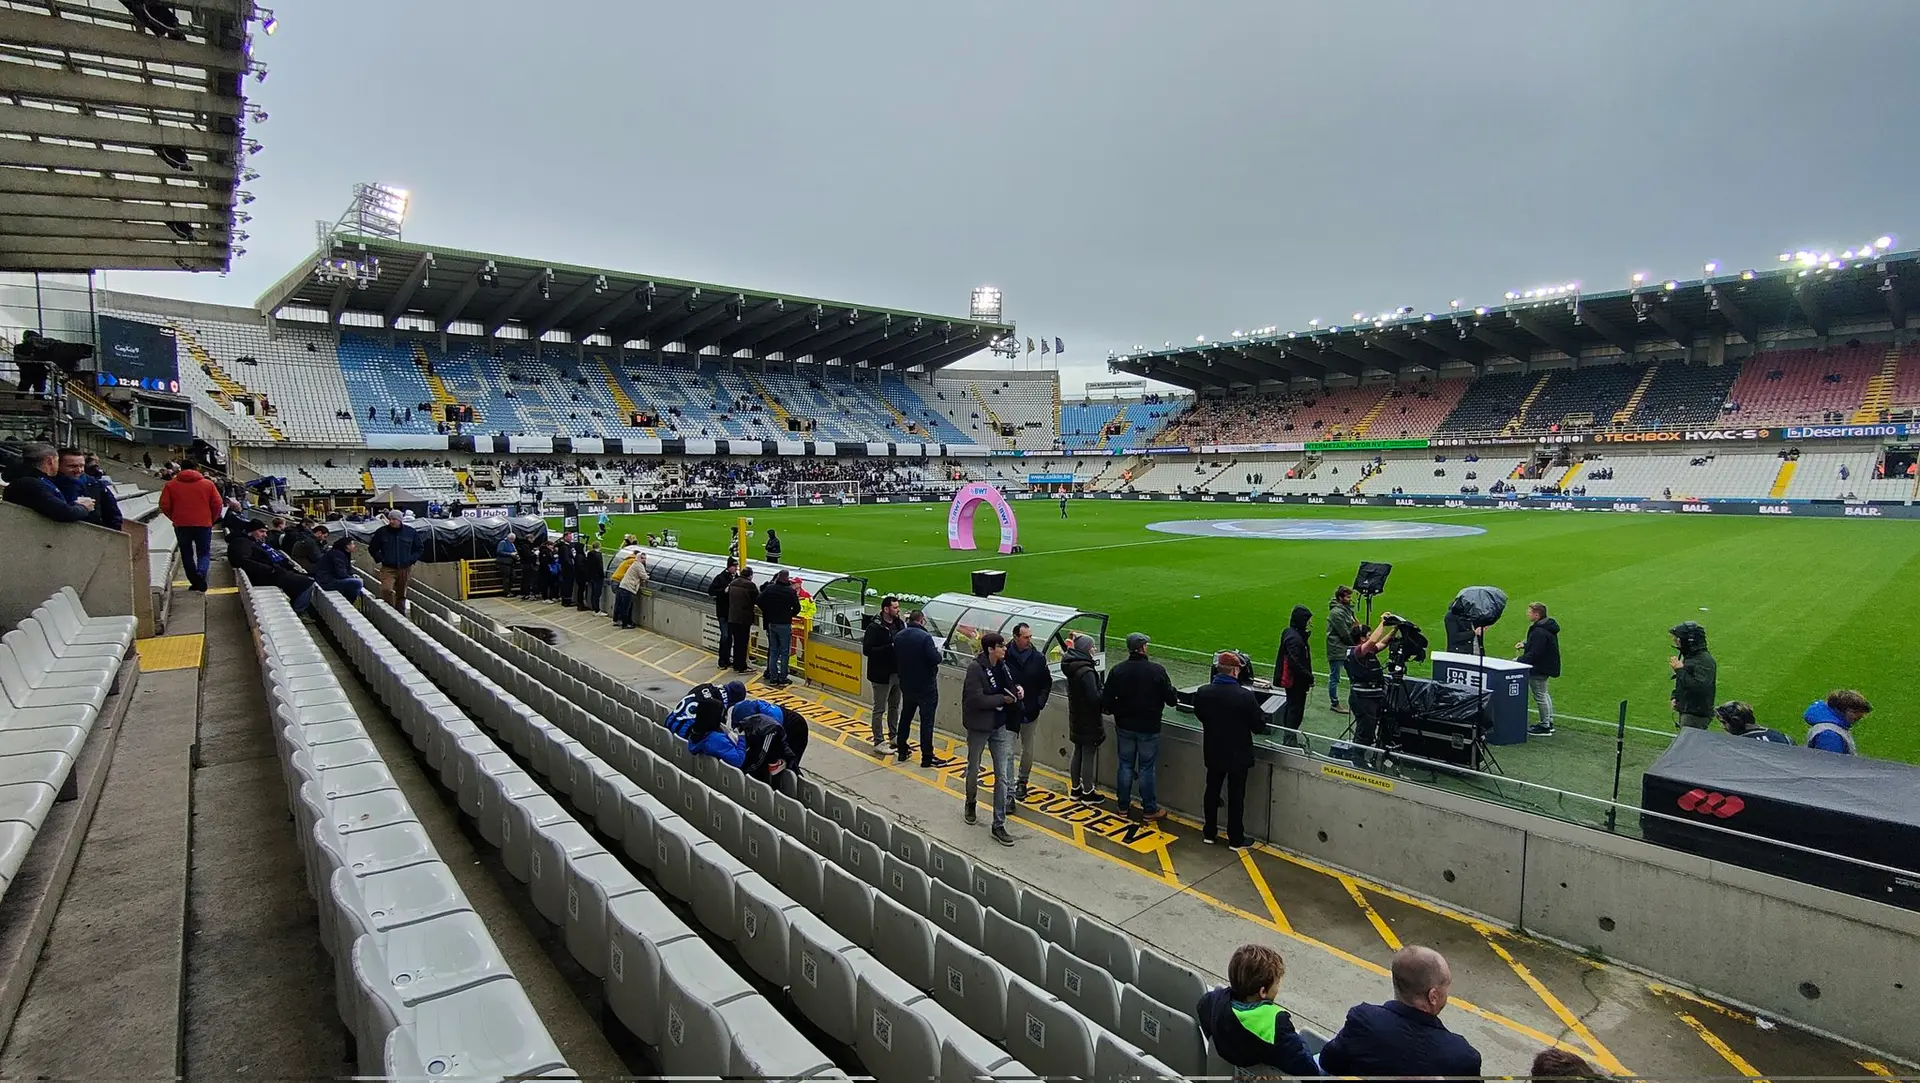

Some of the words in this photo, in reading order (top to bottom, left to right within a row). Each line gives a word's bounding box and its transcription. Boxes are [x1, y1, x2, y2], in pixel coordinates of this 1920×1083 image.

[1604, 432, 1680, 442] TECHBOX
[1685, 429, 1757, 441] HVAC-S
[1802, 426, 1896, 438] Deserranno
[1550, 501, 1575, 509] BALR.
[1682, 504, 1712, 513] BALR.
[1758, 505, 1792, 514] BALR.
[482, 509, 507, 517] Hubo
[999, 507, 1009, 525] BWT
[1844, 507, 1881, 516] BALR.
[1323, 766, 1344, 777] PLEASE
[1345, 771, 1367, 782] REMAIN
[1368, 778, 1391, 788] SEATED
[1021, 785, 1157, 845] OUDEN
